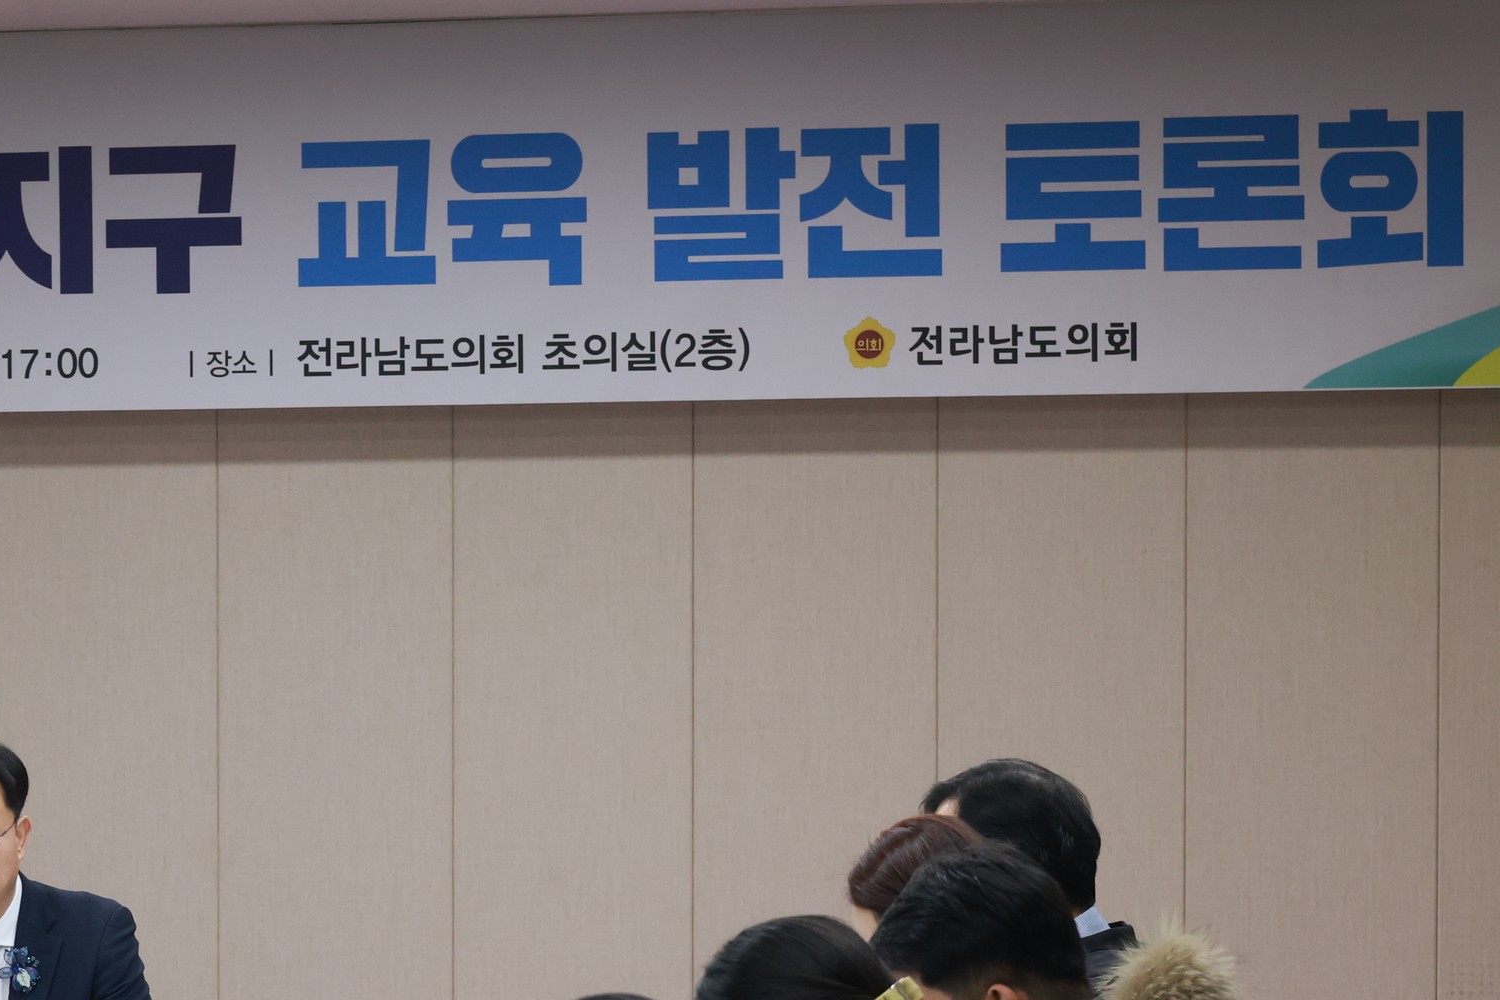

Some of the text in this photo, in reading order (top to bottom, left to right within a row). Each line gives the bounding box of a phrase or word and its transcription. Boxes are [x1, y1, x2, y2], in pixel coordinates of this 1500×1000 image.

[298, 133, 588, 288] 교육
[647, 123, 943, 282] 발전
[1000, 109, 1465, 273] 토론회
[1, 347, 99, 381] 17:00
[297, 334, 524, 377] 전라남도의회
[542, 328, 750, 373] 초의실(2층)
[856, 337, 882, 351] 의회
[908, 321, 1138, 366] 전라남도의회
